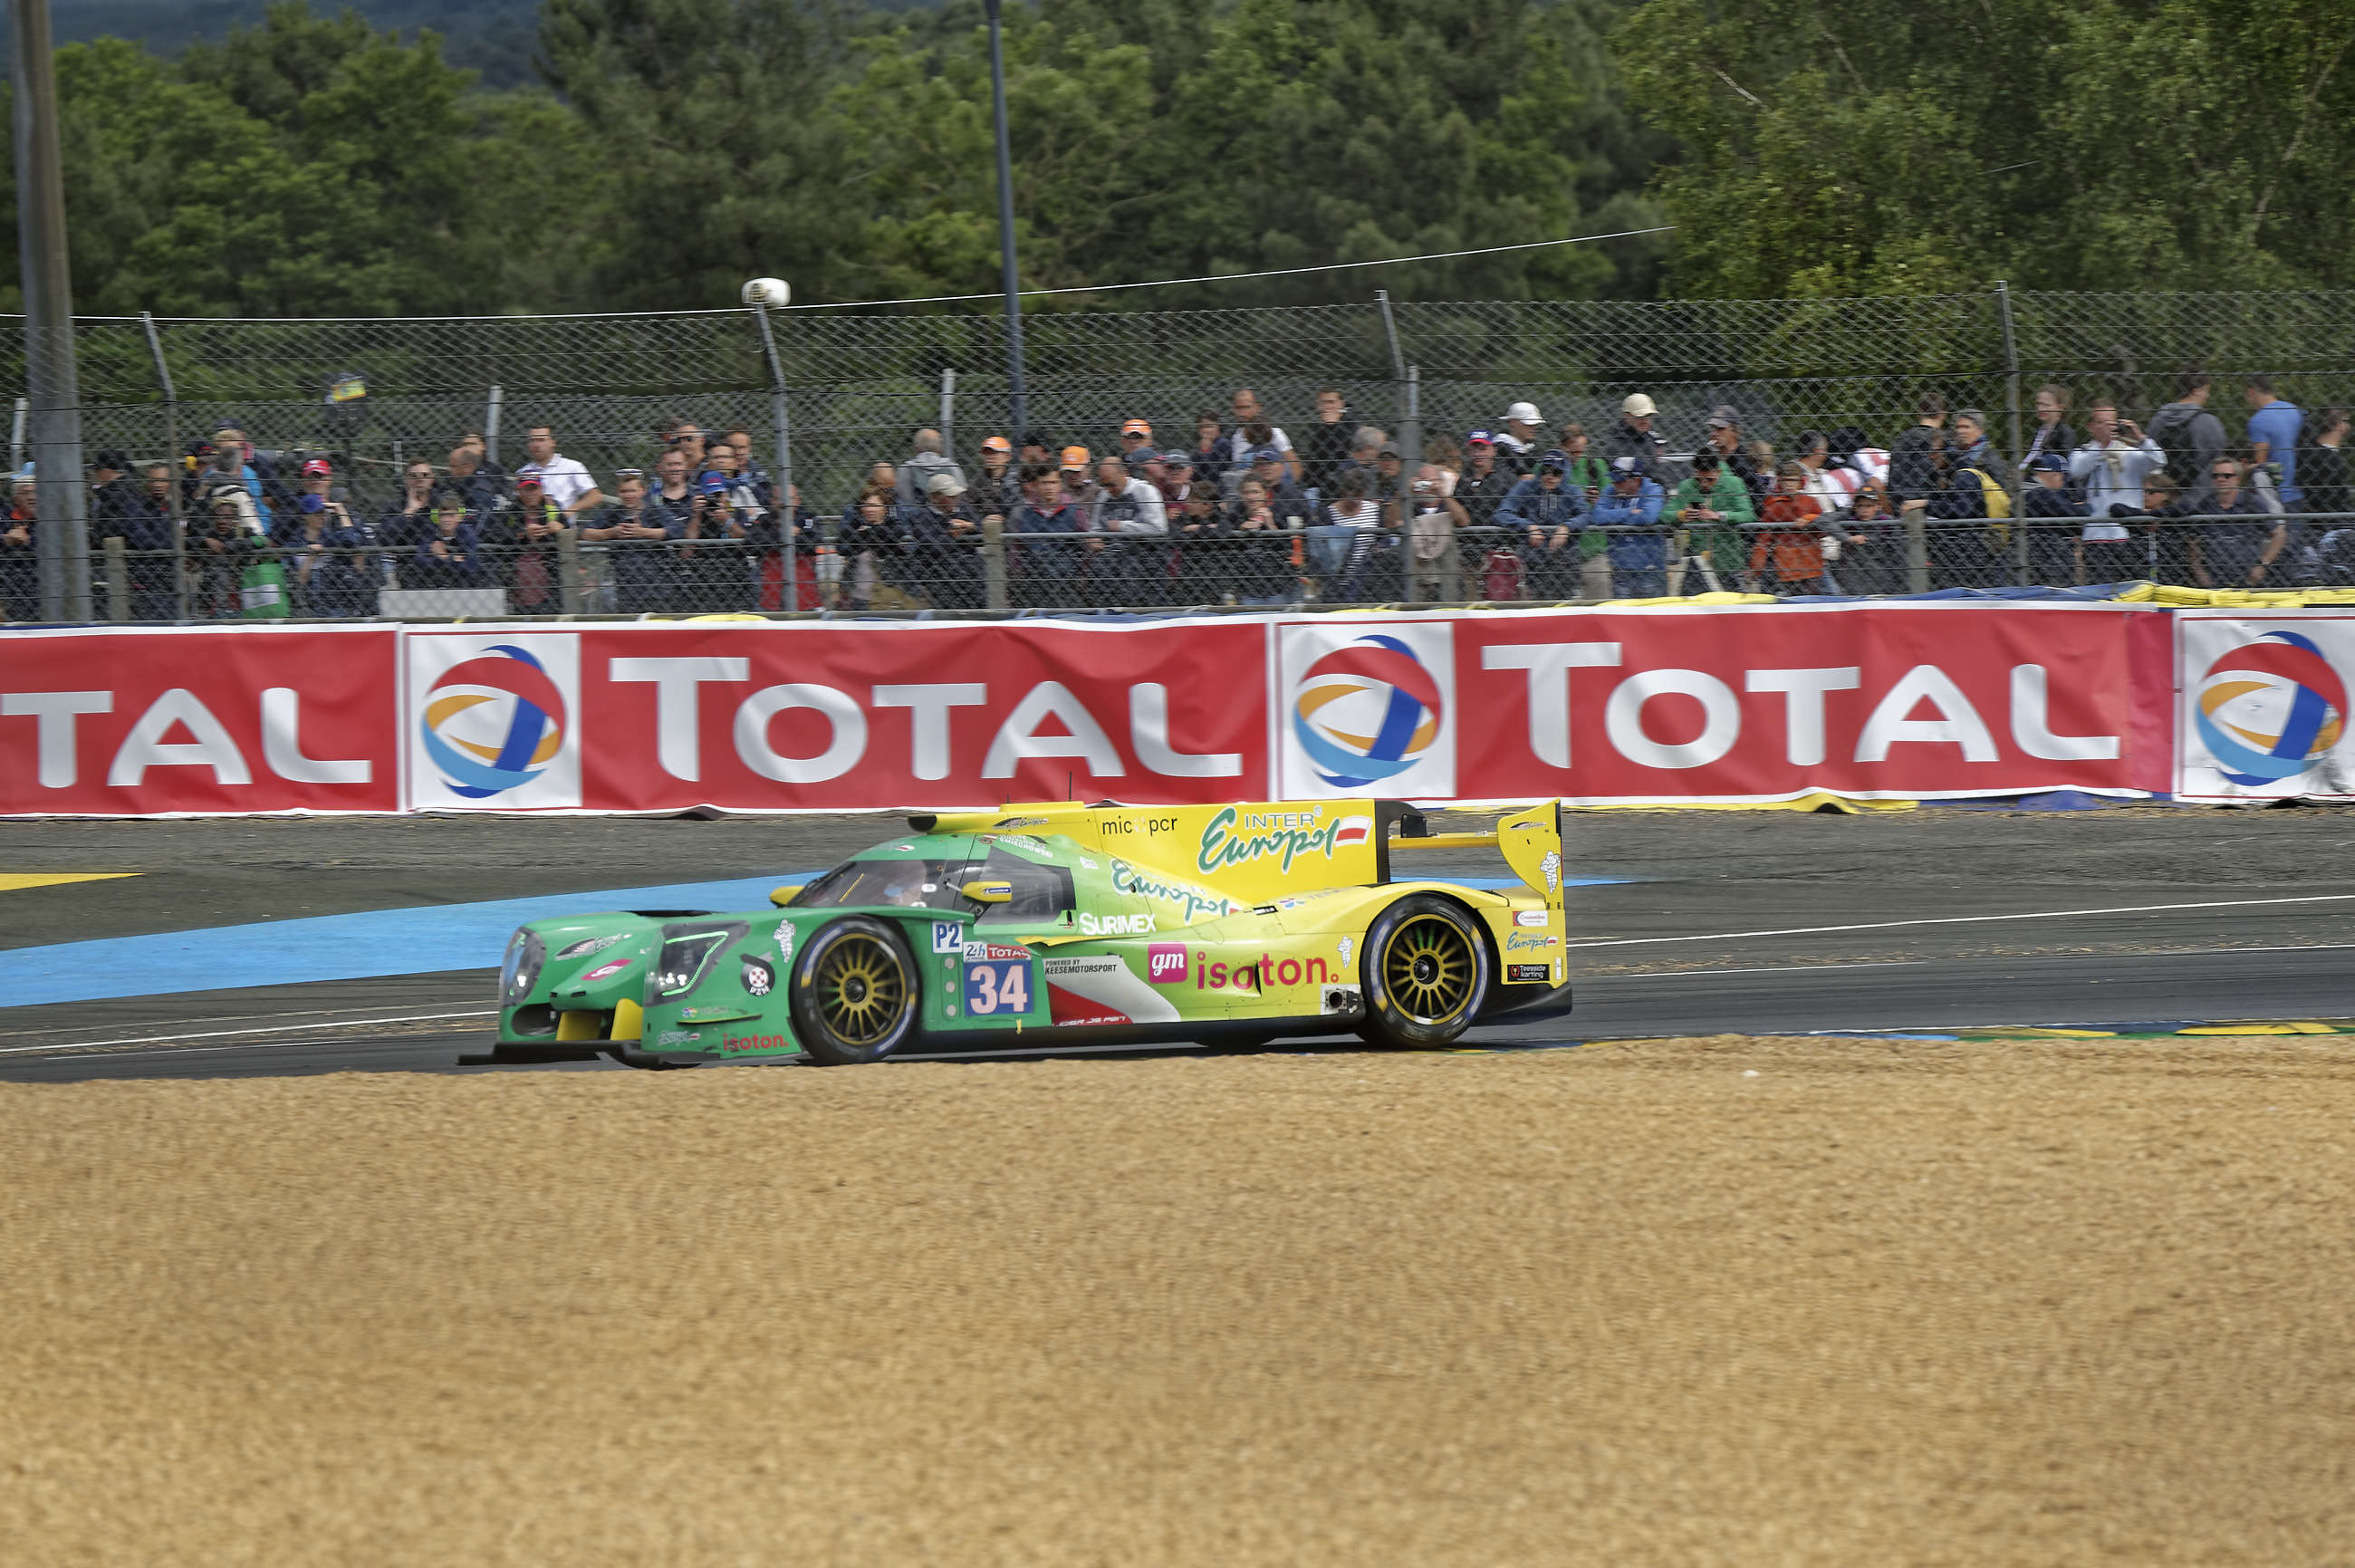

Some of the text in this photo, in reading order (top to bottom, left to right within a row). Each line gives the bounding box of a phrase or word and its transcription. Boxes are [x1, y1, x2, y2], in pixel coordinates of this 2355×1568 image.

[610, 656, 1243, 784] TOTAL
[1481, 641, 2120, 770] TOTAL
[1197, 806, 1341, 872] Europol
[1244, 813, 1315, 828] INTER
[1110, 857, 1229, 924] Europol
[936, 924, 960, 948] P2
[1079, 912, 1157, 935] SURIMEX
[1045, 964, 1117, 975] KEESEMOTORSPORT
[1151, 952, 1185, 976] gm
[970, 965, 1028, 1015] 34
